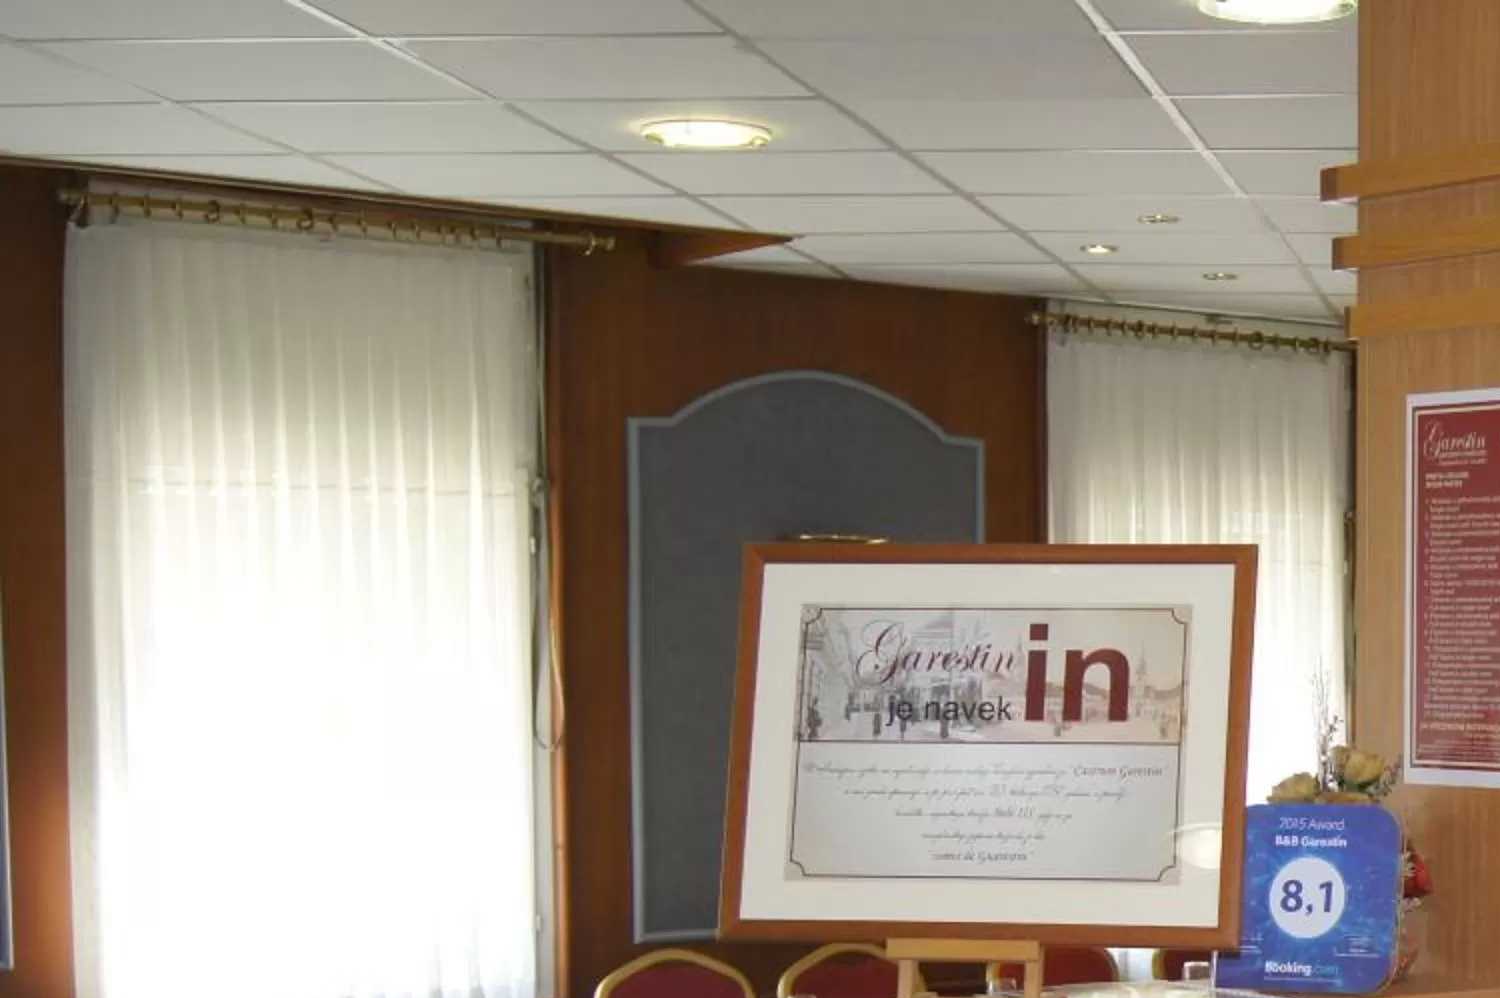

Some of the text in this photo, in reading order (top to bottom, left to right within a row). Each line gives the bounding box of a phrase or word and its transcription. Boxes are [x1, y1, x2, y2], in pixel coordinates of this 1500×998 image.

[855, 619, 1014, 686] Garestin
[1024, 623, 1131, 722] in
[886, 695, 1013, 726] je navek
[1279, 816, 1345, 831] 2015 Award
[1275, 835, 1347, 848] B&B Garestin
[1279, 879, 1333, 916] 8,1
